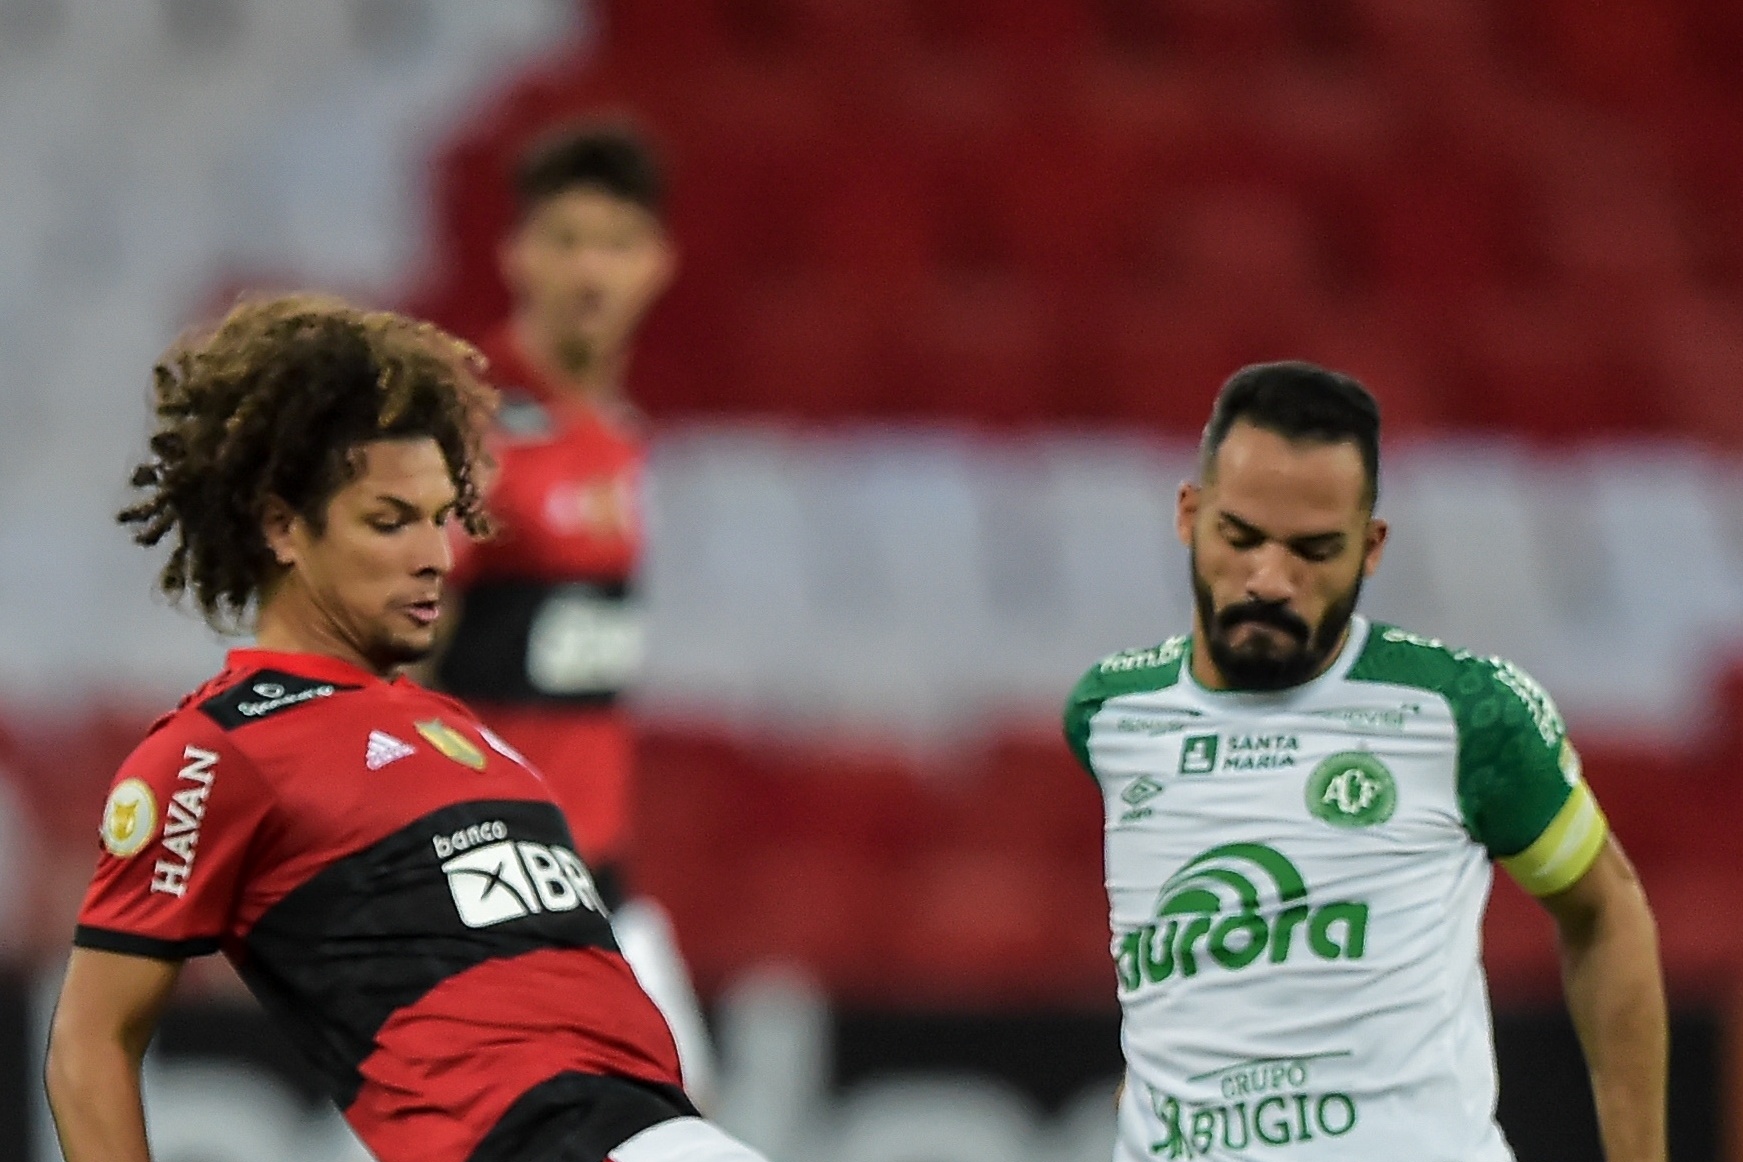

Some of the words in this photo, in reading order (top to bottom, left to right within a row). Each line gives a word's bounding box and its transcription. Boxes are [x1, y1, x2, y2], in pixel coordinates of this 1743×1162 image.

[151, 744, 220, 898] HAVAN
[433, 820, 508, 858] banco
[515, 841, 609, 919] BR
[1117, 900, 1369, 992] aurora
[1221, 1062, 1306, 1099] GRUPO
